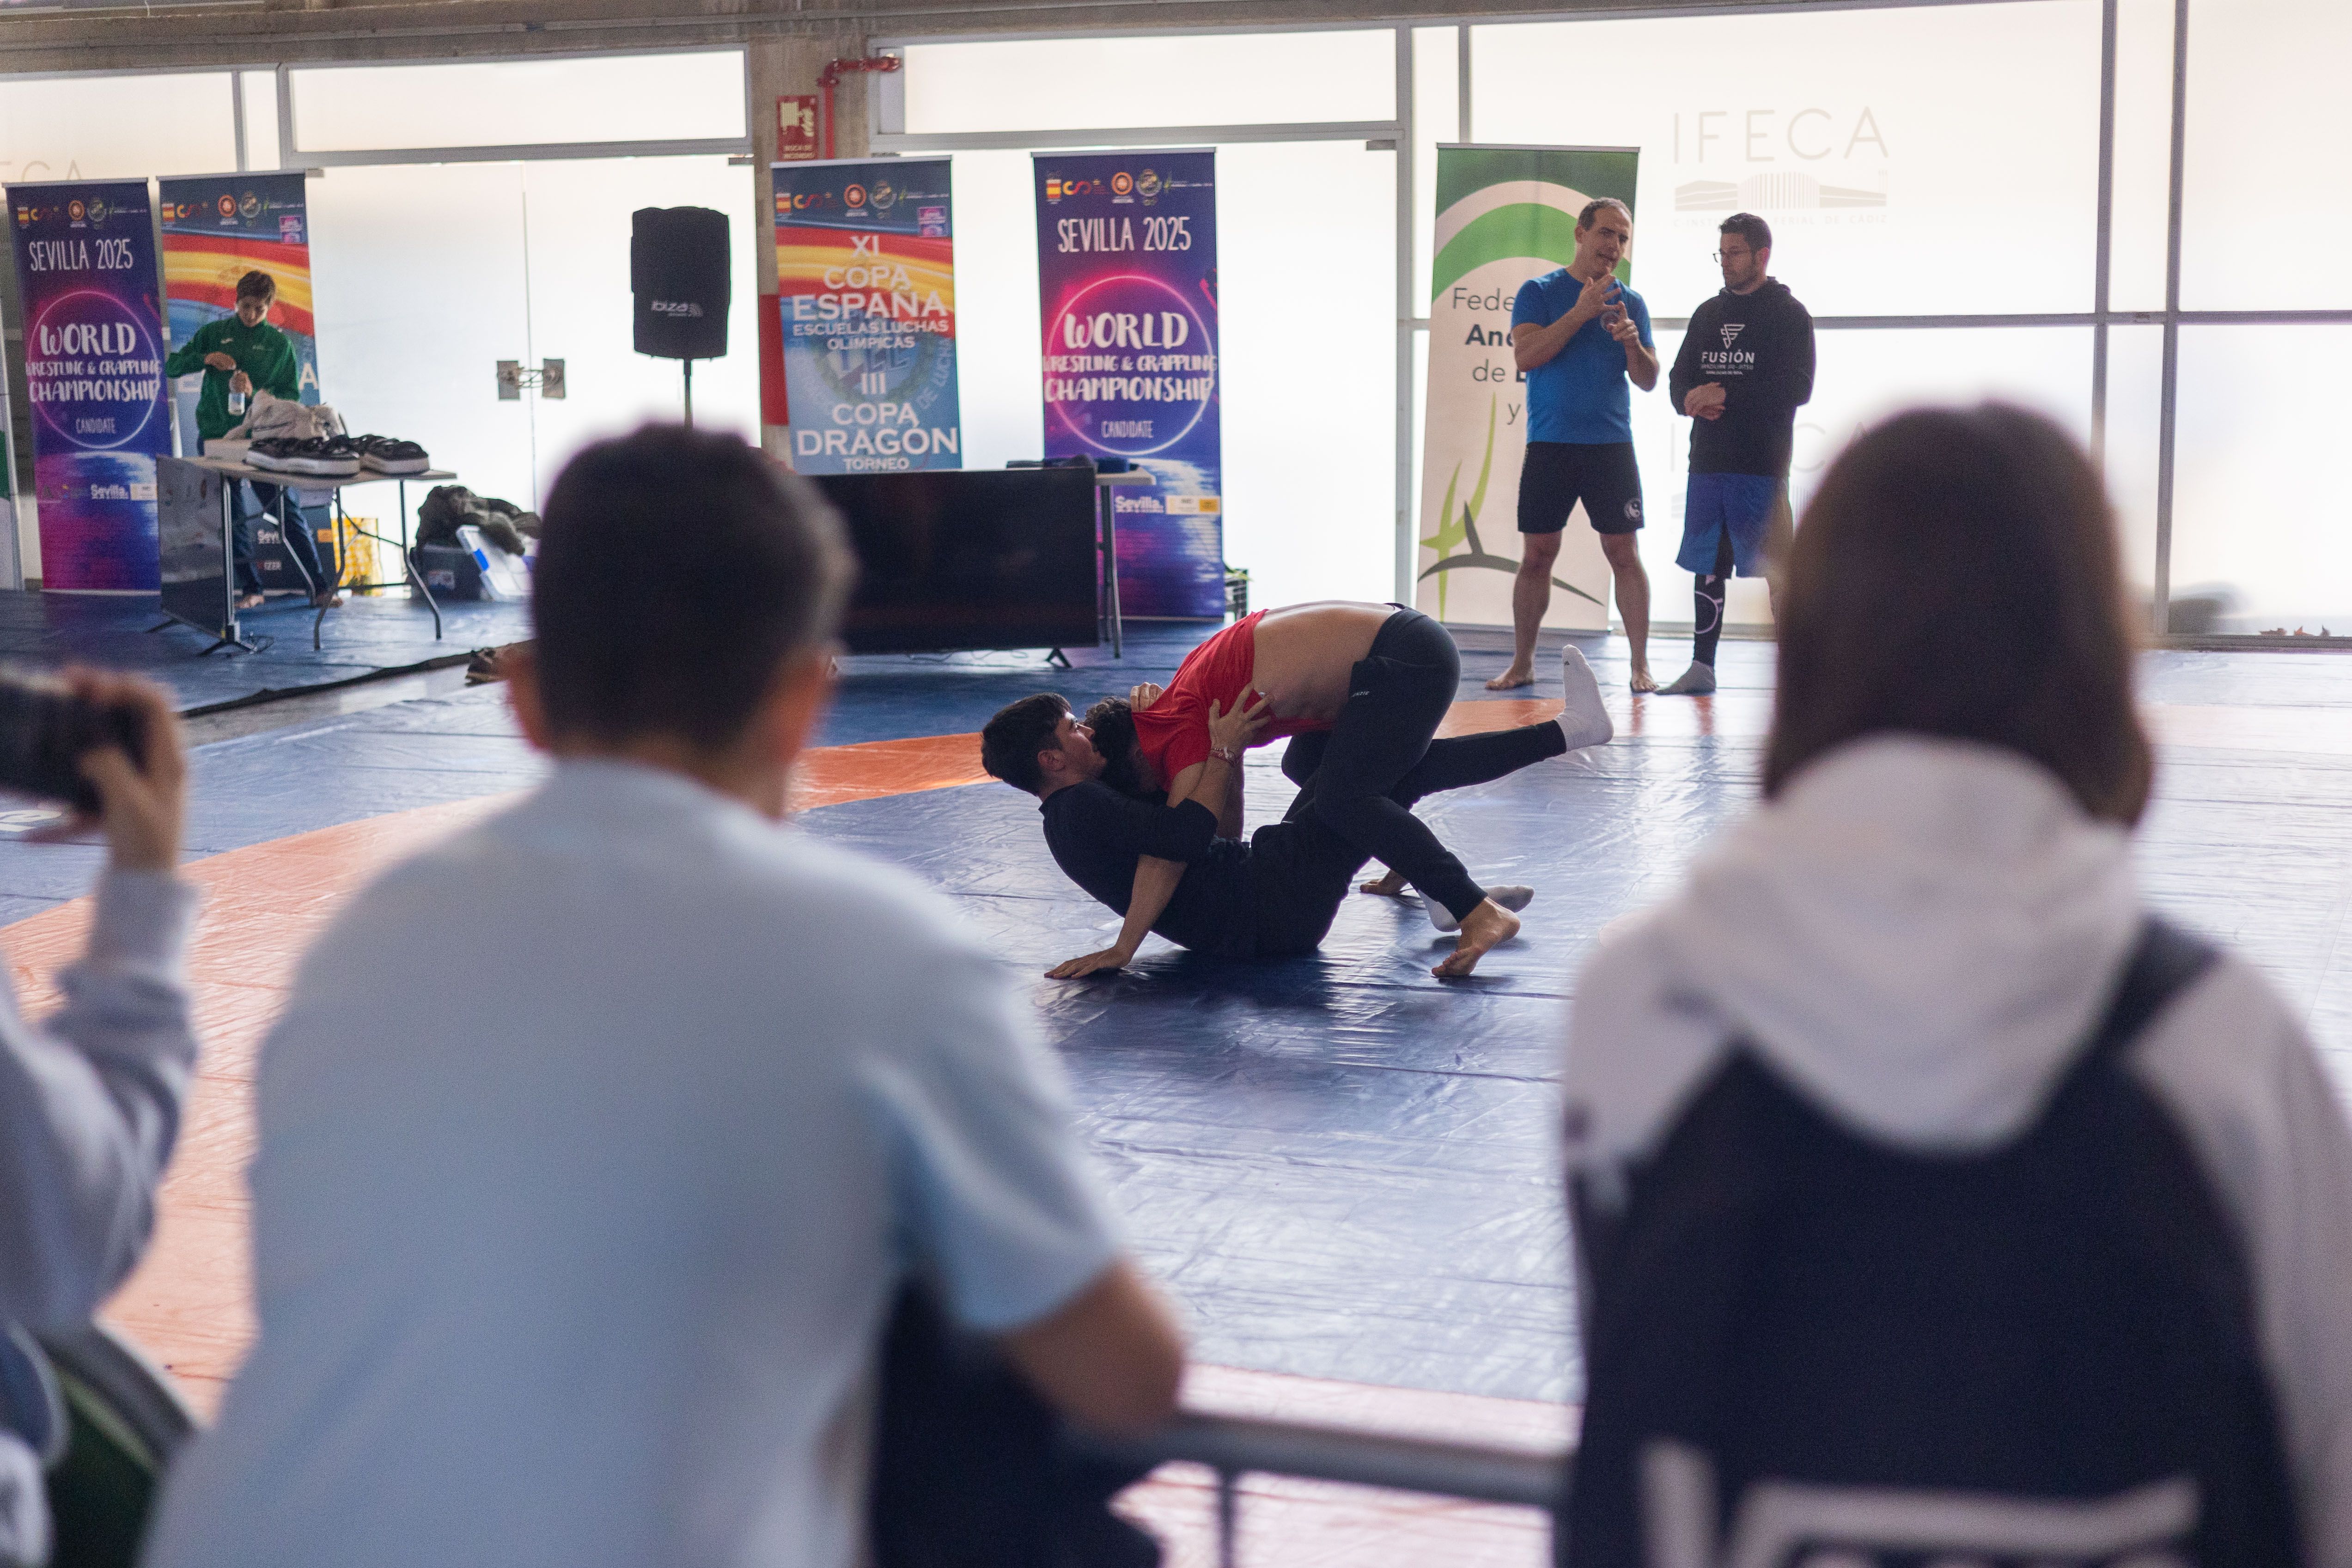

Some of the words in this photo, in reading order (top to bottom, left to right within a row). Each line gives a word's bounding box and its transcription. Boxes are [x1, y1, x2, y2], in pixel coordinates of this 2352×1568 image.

[1674, 106, 1889, 165] IFECA
[1058, 217, 1135, 252] SEVILLA
[1143, 216, 1192, 251] 2025
[29, 239, 90, 272] SEVILLA
[96, 238, 134, 270] 2025
[851, 235, 881, 258] XI
[824, 264, 912, 290] COPA
[1452, 287, 1514, 311] Fede
[40, 323, 136, 356] WORLD
[793, 321, 879, 336] ESCUELAS
[881, 319, 949, 334] LUCHAS
[1064, 311, 1189, 349] WORLD
[1137, 354, 1217, 372] GRAPPLING
[1701, 349, 1755, 363] FUSIÓN
[1472, 359, 1506, 383] de
[29, 379, 161, 403] CHAMPIONSHIP
[860, 372, 887, 395] III
[1045, 376, 1215, 403] CHAMPIONSHIP
[76, 417, 116, 434] CANDIDATE
[832, 402, 918, 426] COPA
[1506, 403, 1521, 425] y
[1101, 420, 1154, 439] CANDIDATE
[842, 457, 910, 471] TORNEO
